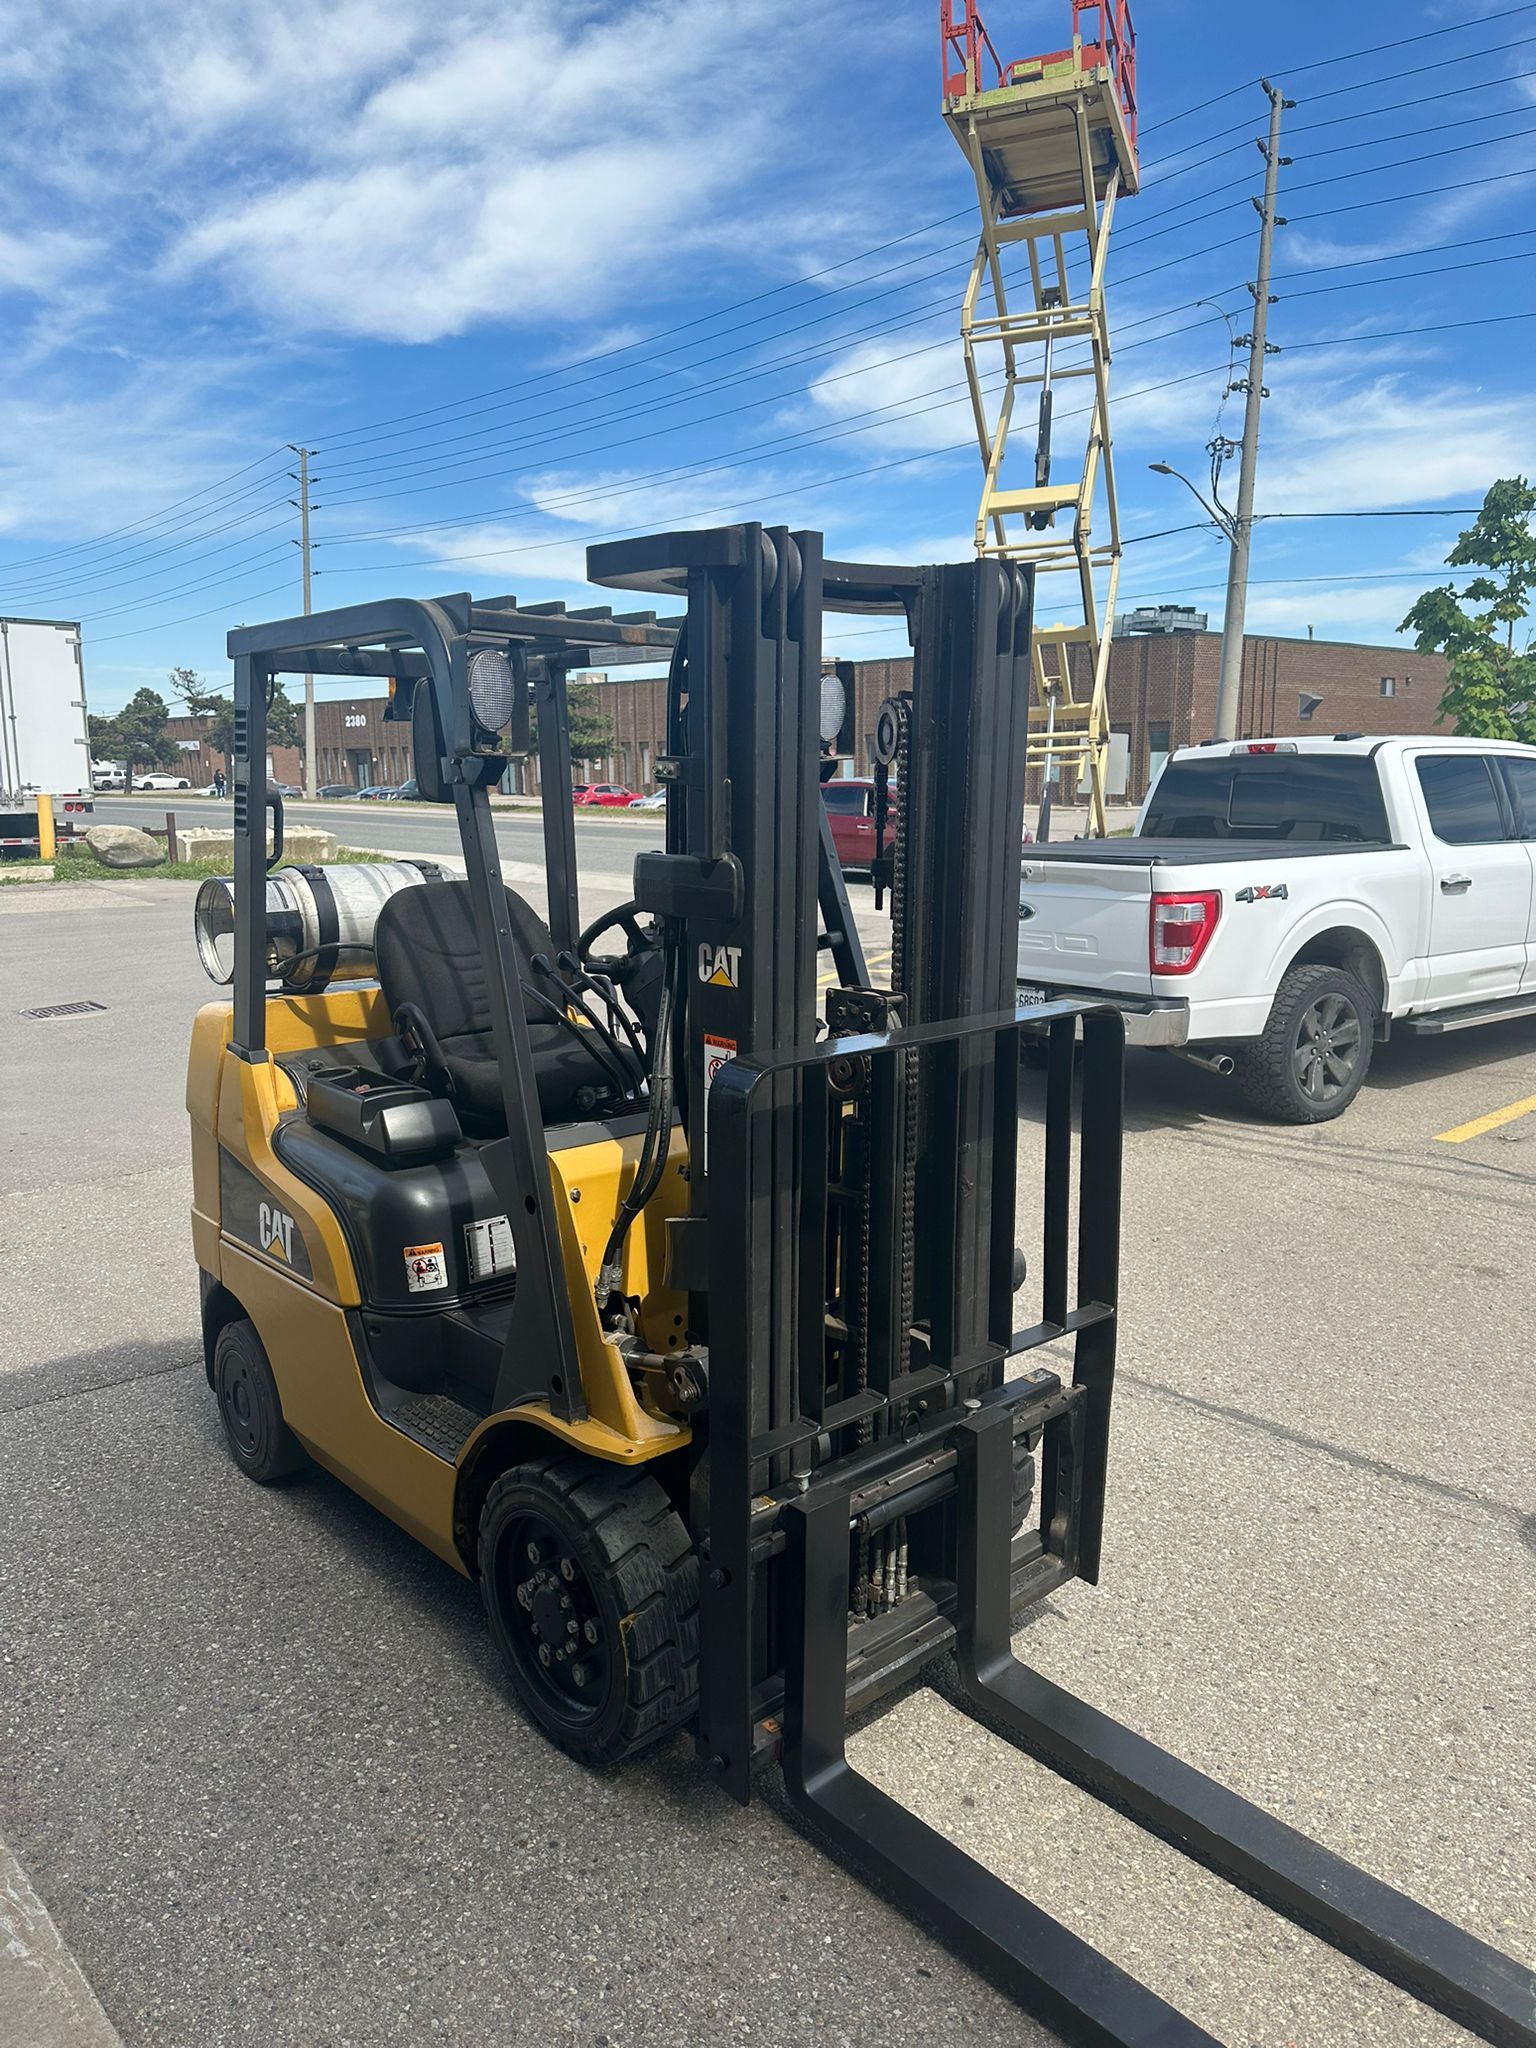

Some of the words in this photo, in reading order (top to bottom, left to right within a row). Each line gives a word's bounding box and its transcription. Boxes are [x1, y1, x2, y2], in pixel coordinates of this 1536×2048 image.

[345, 714, 367, 728] 2380
[698, 942, 742, 988] CAT
[259, 1202, 294, 1265] CAT
